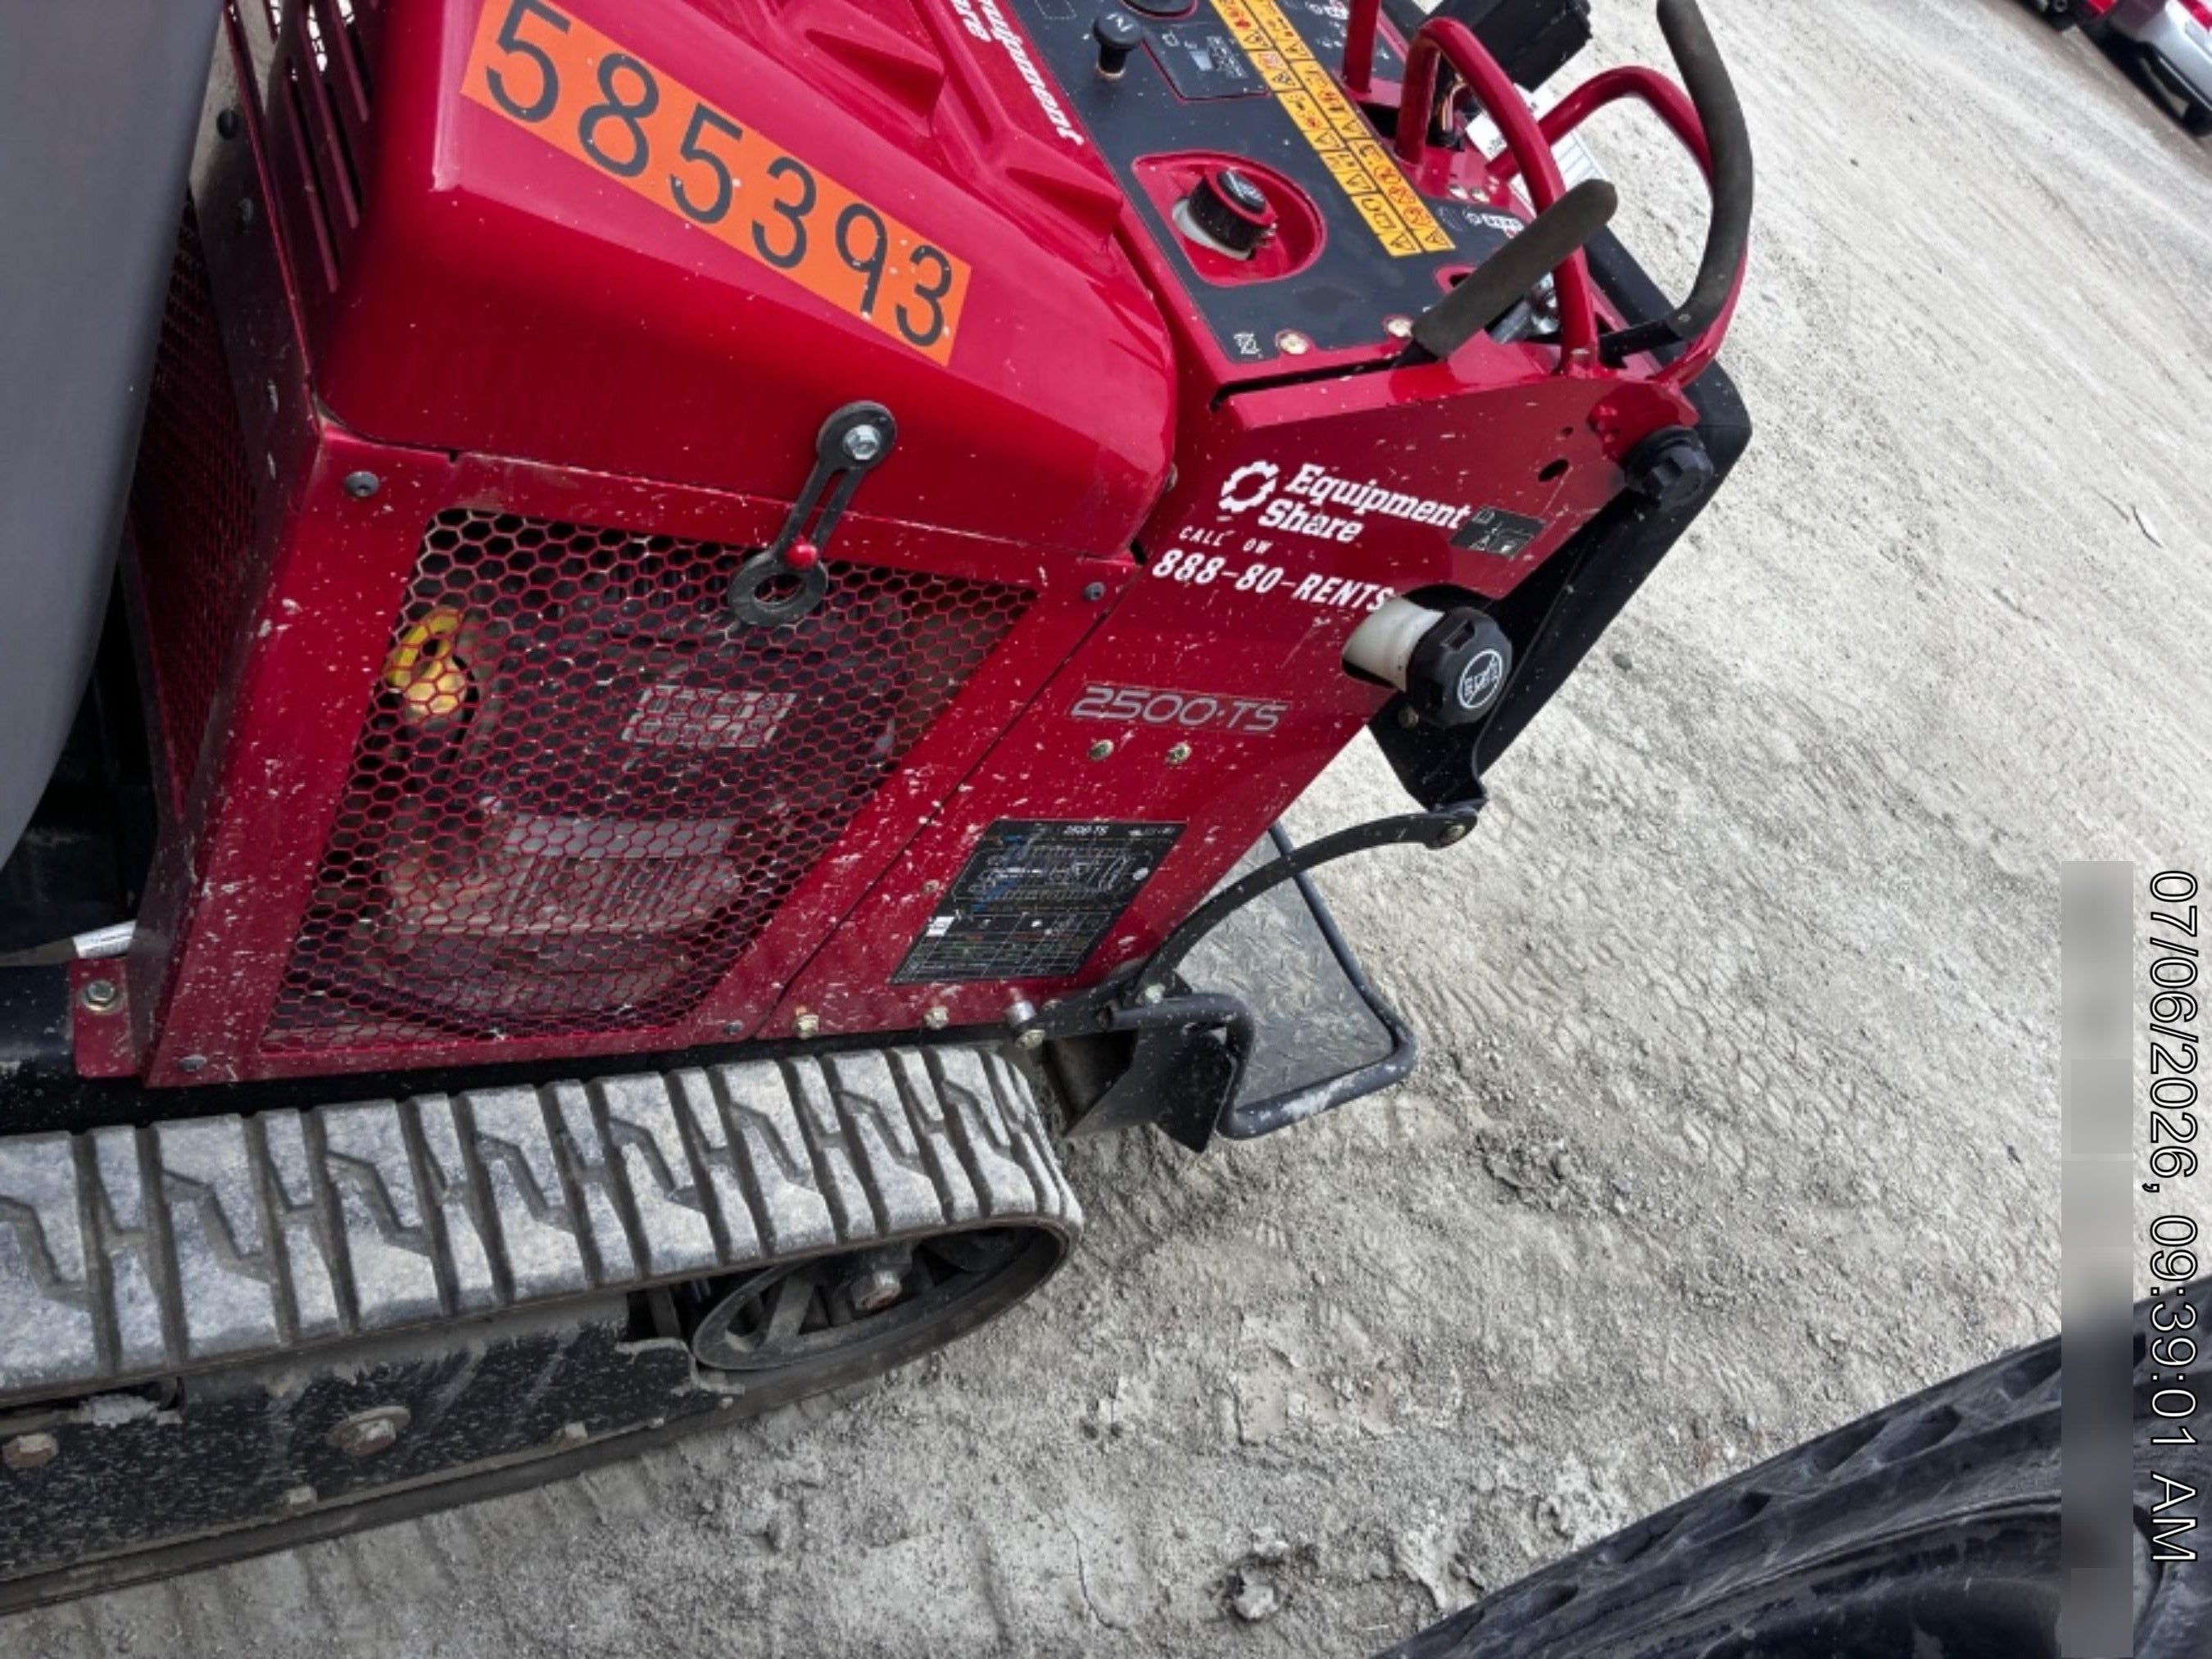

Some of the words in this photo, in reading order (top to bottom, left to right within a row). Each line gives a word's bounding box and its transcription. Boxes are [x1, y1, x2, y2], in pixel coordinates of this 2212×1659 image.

[487, 0, 953, 347] 585393
[1258, 498, 1364, 543] Share
[1285, 463, 1471, 529] Equipment
[1178, 525, 1224, 547] CALL
[1152, 547, 1394, 611] 888-80-RENTS
